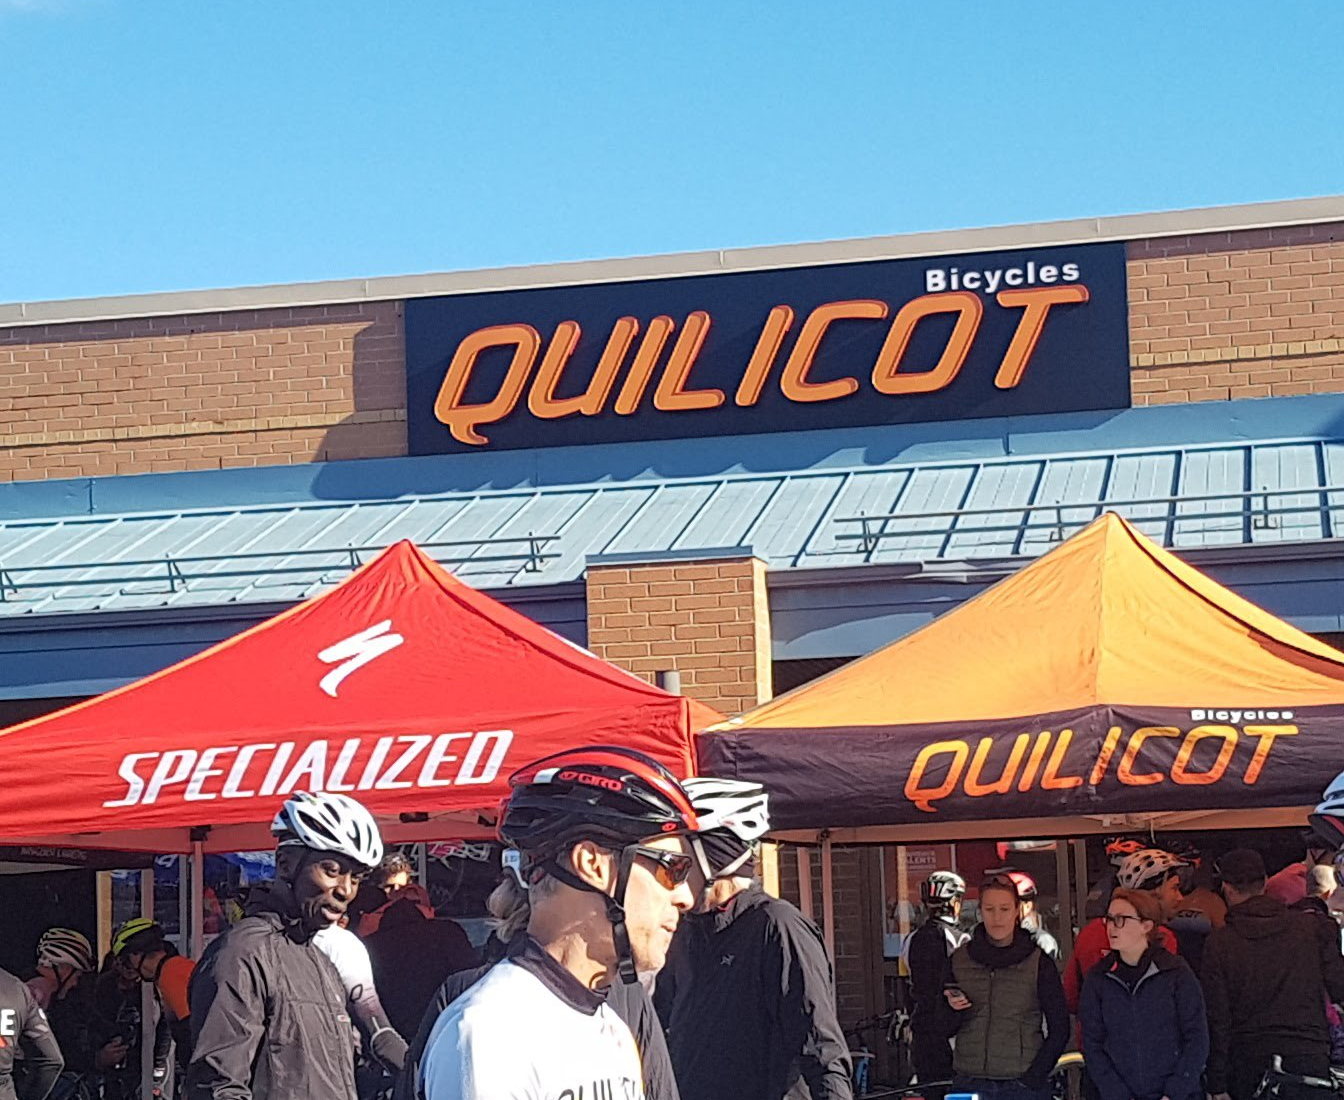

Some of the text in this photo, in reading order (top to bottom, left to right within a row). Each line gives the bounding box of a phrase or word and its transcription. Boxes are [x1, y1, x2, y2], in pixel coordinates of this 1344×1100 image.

[924, 259, 1082, 295] Bicycles
[433, 283, 1089, 445] QUILICOT
[1190, 709, 1295, 723] Bicycles
[101, 729, 516, 809] SPECIALIZED
[578, 770, 623, 791] GIRO
[903, 724, 1299, 813] QUILICOT
